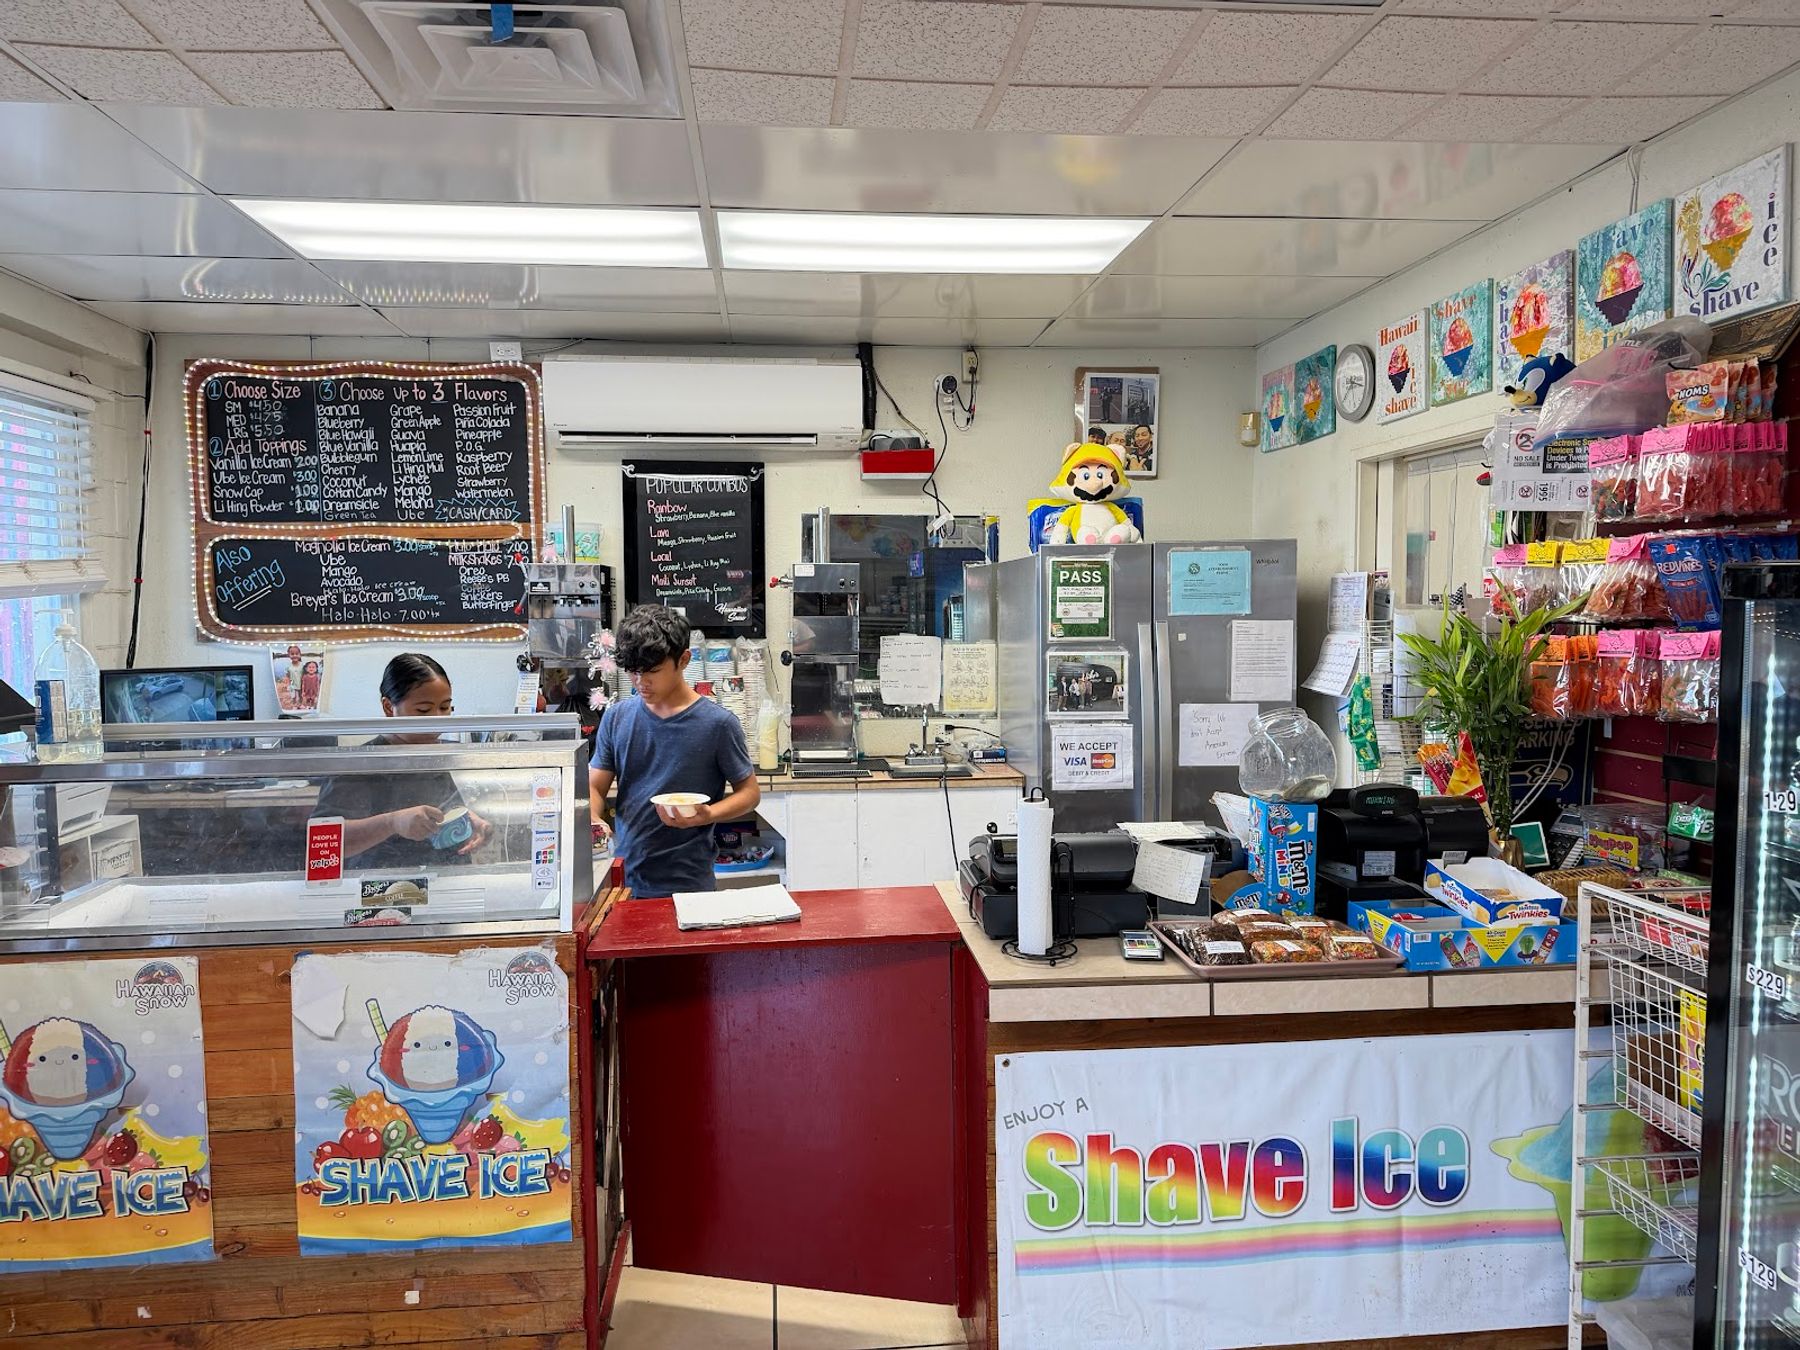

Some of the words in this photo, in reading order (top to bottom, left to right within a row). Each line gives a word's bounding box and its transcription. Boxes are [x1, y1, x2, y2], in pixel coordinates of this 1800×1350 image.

[1689, 279, 1760, 317] shave
[1379, 314, 1418, 347] Hawaii
[224, 381, 268, 399] Choose
[271, 380, 301, 399] Size
[340, 381, 385, 401] Choose
[393, 386, 409, 402] Up
[412, 382, 426, 400] to
[432, 382, 445, 401] 3
[455, 382, 507, 402] Flavors
[225, 401, 242, 413] SM
[316, 404, 360, 416] Banana
[389, 404, 423, 418] Grape
[452, 403, 492, 417] Passion
[492, 402, 517, 416] Fruit
[1385, 395, 1417, 416] shave
[226, 414, 247, 427] MED
[317, 416, 365, 429] Blueberry
[391, 417, 420, 429] Green
[420, 414, 442, 429] Apple
[476, 416, 510, 428] Colada
[227, 427, 249, 439] LRG
[318, 429, 340, 440] Blue
[341, 427, 375, 440] Hawaii
[390, 429, 426, 440] Guava
[455, 429, 502, 442] Pineapple
[224, 439, 251, 456] Add
[255, 438, 307, 456] Toppings
[319, 440, 344, 452] Blue
[344, 439, 379, 452] Vanilla
[209, 453, 247, 470] Vanilla
[250, 454, 263, 469] Ice
[263, 454, 292, 469] Cream
[320, 452, 378, 464] Bubblegum
[390, 451, 421, 463] Lemon
[421, 452, 444, 463] Lime
[456, 452, 513, 464] Raspberry
[321, 463, 356, 475] Cherry
[392, 463, 402, 474] Li
[403, 462, 425, 476] Hing
[456, 464, 480, 476] Root
[482, 462, 508, 475] Beer
[213, 472, 236, 484] Ube
[239, 471, 252, 484] Ice
[252, 470, 285, 484] Cream
[322, 474, 367, 488] Coconut
[393, 474, 431, 486] Lychee
[457, 476, 509, 488] Strawberry
[323, 486, 355, 498] Cotton
[355, 482, 388, 498] Candy
[393, 485, 432, 498] Mango
[645, 478, 703, 494] POPULAR
[706, 477, 748, 493] COMBOS
[213, 486, 243, 498] Snow
[244, 486, 264, 500] Cap
[455, 487, 514, 499] Watermelon
[214, 500, 224, 513] Li
[227, 501, 248, 518] Hing
[250, 499, 285, 512] Powder
[323, 498, 380, 511] Dreamsicle
[647, 499, 688, 514] Rainbow
[324, 511, 357, 521] Green
[362, 511, 377, 519] Tea
[397, 510, 426, 521] Ube
[649, 526, 670, 538] Lava
[295, 541, 345, 555] Magnolia
[348, 540, 361, 553] Ice
[361, 540, 391, 553] Cream
[216, 546, 252, 574] Also
[320, 554, 347, 566] Ube
[650, 550, 673, 562] Local
[321, 565, 358, 579] Mango
[459, 566, 486, 575] Oreo
[1060, 570, 1102, 584] PASS
[216, 559, 286, 603] Offering
[320, 576, 363, 588] Avocado
[496, 573, 510, 583] PB
[672, 573, 697, 586] Sunset
[290, 592, 338, 611] Breyer's
[343, 591, 358, 604] Ice
[359, 590, 393, 603] Cream
[460, 592, 503, 601] Snickers
[462, 600, 518, 612] Butterfinger
[1060, 743, 1076, 751] WE
[1078, 742, 1118, 750] ACCEPT
[1517, 731, 1575, 749] ARKING
[1064, 756, 1087, 766] VISA
[310, 858, 330, 869] yelp
[1442, 888, 1469, 910] Twinkies
[1508, 910, 1548, 920] Twinkies
[1749, 966, 1783, 995] $2.29
[1003, 1100, 1066, 1131] ENJOY
[1075, 1097, 1090, 1112] A
[319, 1153, 470, 1206] SHAVE
[482, 1147, 554, 1203] ICE
[1022, 1130, 1308, 1232] Shave
[1329, 1116, 1469, 1211] Ice
[0, 1170, 103, 1222] AVE
[112, 1166, 189, 1217] ICE
